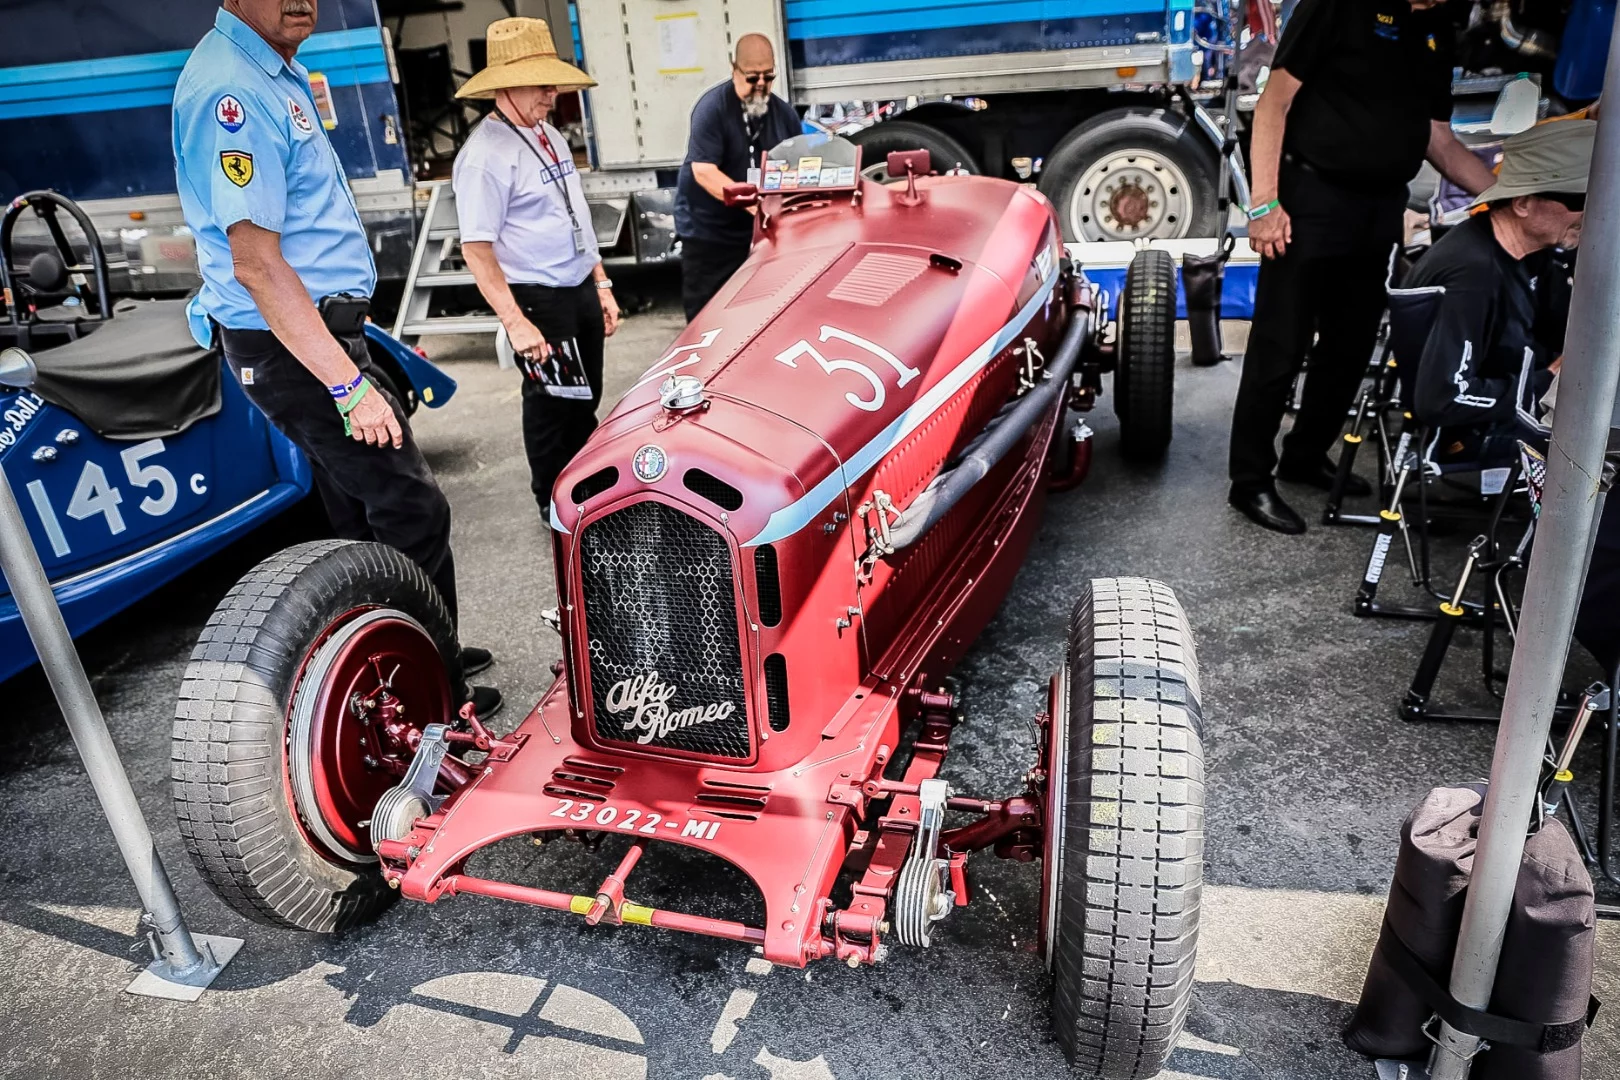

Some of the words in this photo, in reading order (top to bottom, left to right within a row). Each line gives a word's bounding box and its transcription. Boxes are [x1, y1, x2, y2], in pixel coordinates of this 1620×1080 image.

[774, 325, 920, 411] 31
[4, 395, 39, 432] Doll
[26, 438, 178, 558] 145
[606, 671, 677, 731] Alfa
[637, 700, 736, 745] Romeo
[549, 799, 722, 841] 23022-MI
